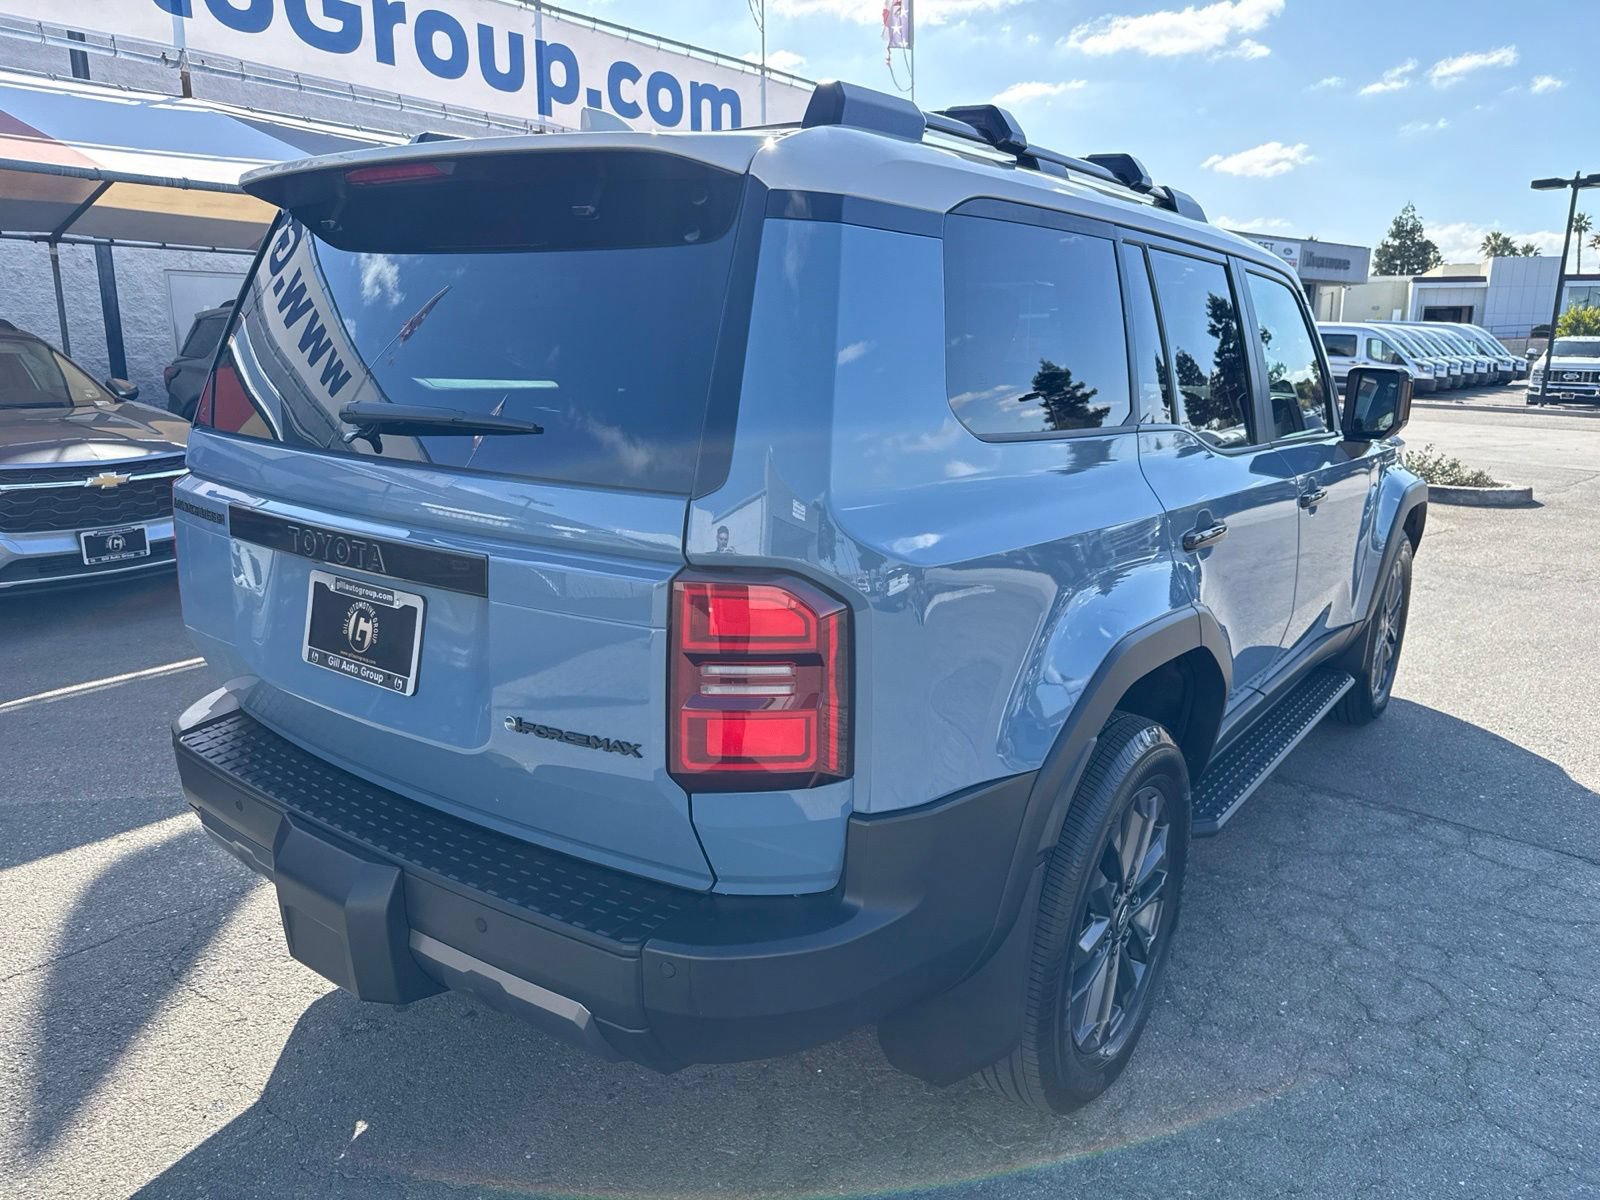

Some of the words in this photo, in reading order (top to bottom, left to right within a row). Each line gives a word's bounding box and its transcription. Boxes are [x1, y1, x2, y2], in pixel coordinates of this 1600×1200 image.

[150, 0, 742, 132] Group.com
[287, 525, 387, 573] TOYOTA
[327, 655, 341, 669] Gill
[341, 660, 359, 675] Auto
[360, 666, 384, 684] Group
